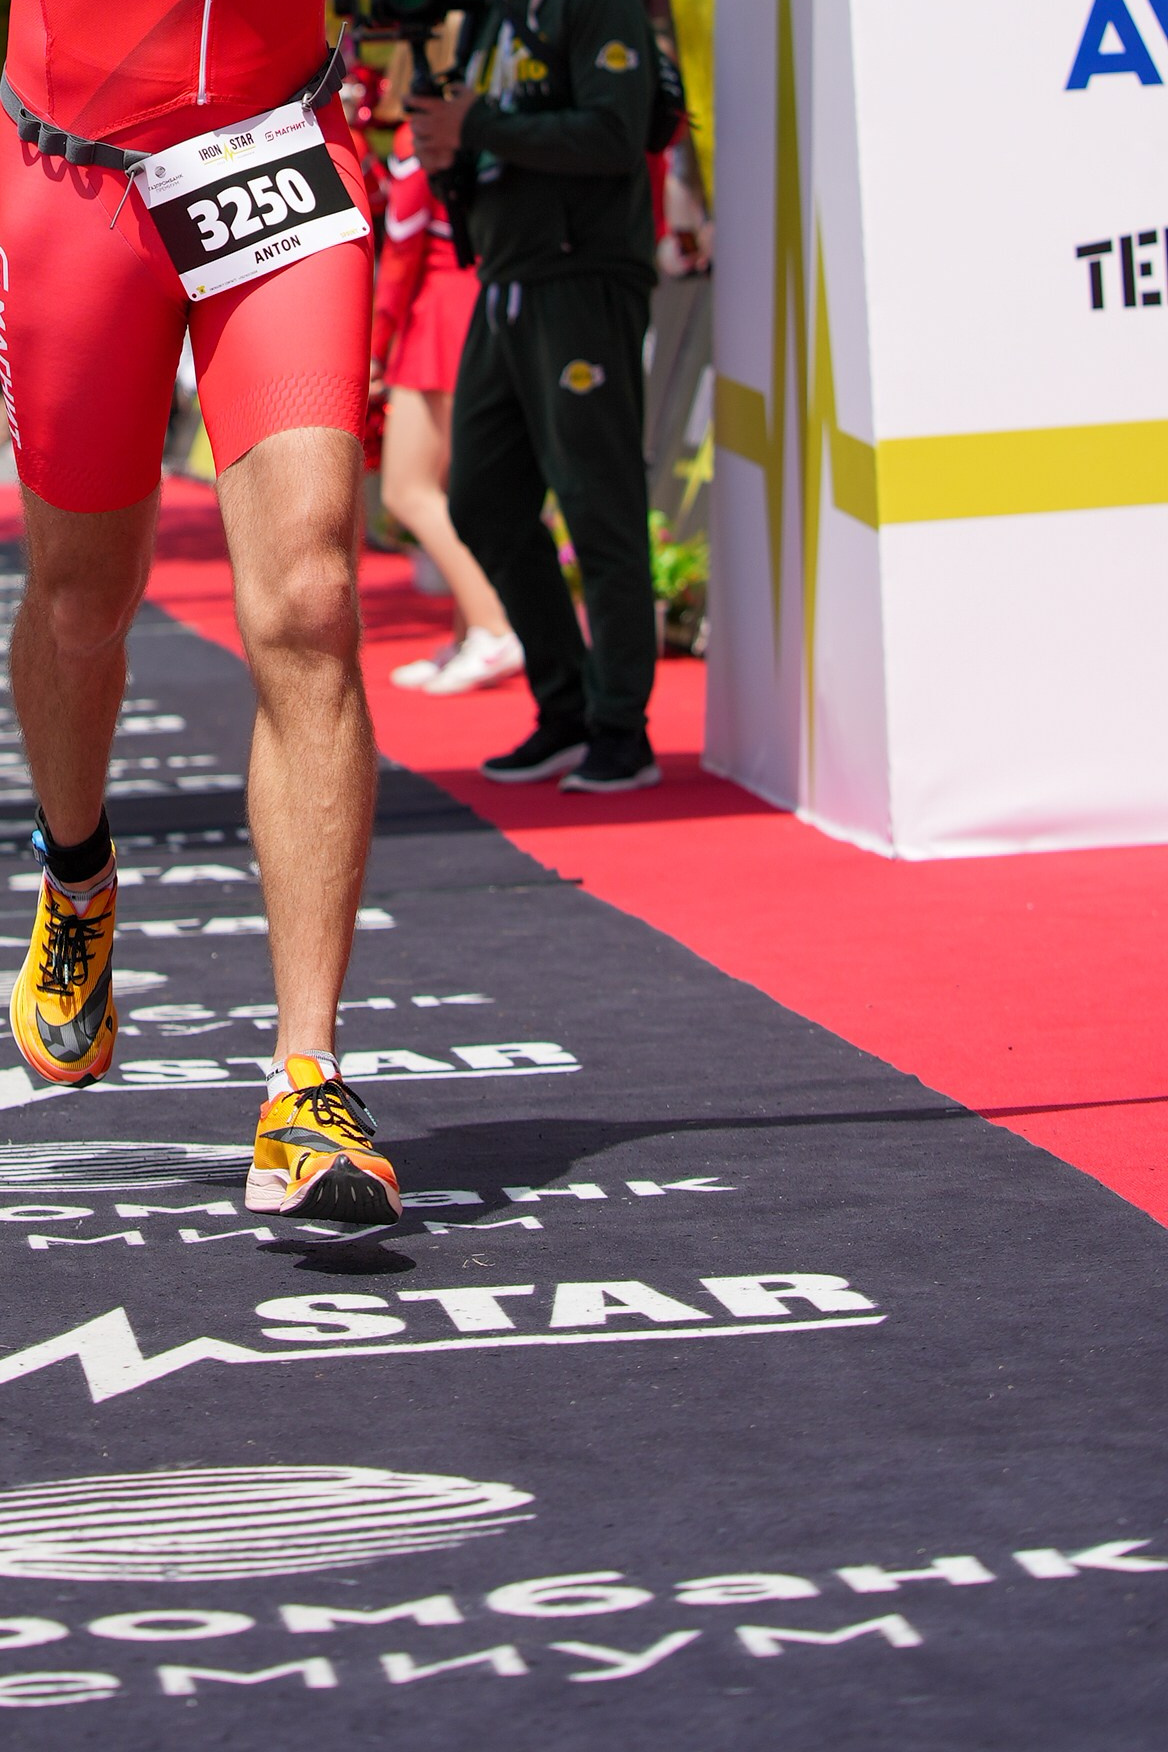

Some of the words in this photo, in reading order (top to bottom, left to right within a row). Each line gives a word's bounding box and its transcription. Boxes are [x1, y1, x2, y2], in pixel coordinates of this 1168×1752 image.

[198, 144, 223, 161] IRON
[229, 133, 254, 150] STAR
[187, 168, 316, 252] 3250
[254, 234, 302, 265] ANTON
[1076, 227, 1168, 310] TE
[254, 1273, 879, 1342] STAR
